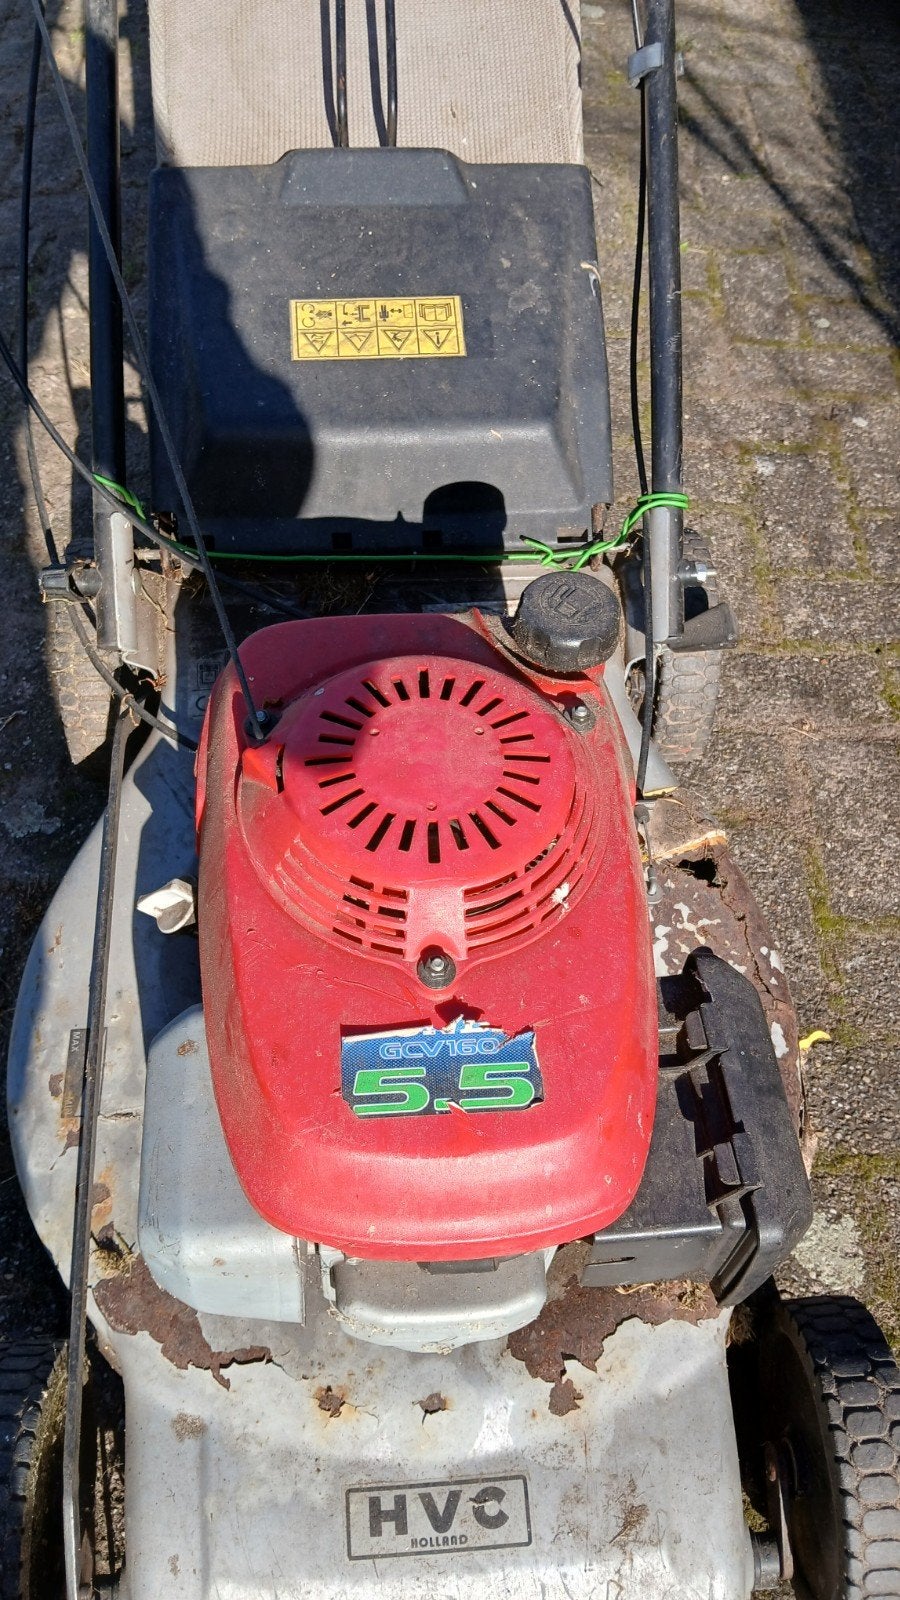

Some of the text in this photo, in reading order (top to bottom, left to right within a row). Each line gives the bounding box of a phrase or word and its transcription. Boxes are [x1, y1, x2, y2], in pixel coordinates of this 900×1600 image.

[70, 1031, 81, 1053] MAX
[379, 1037, 499, 1060] GCV160
[353, 1062, 535, 1115] 5.5
[368, 1485, 510, 1537] HVC
[410, 1534, 469, 1549] HOLLAND
